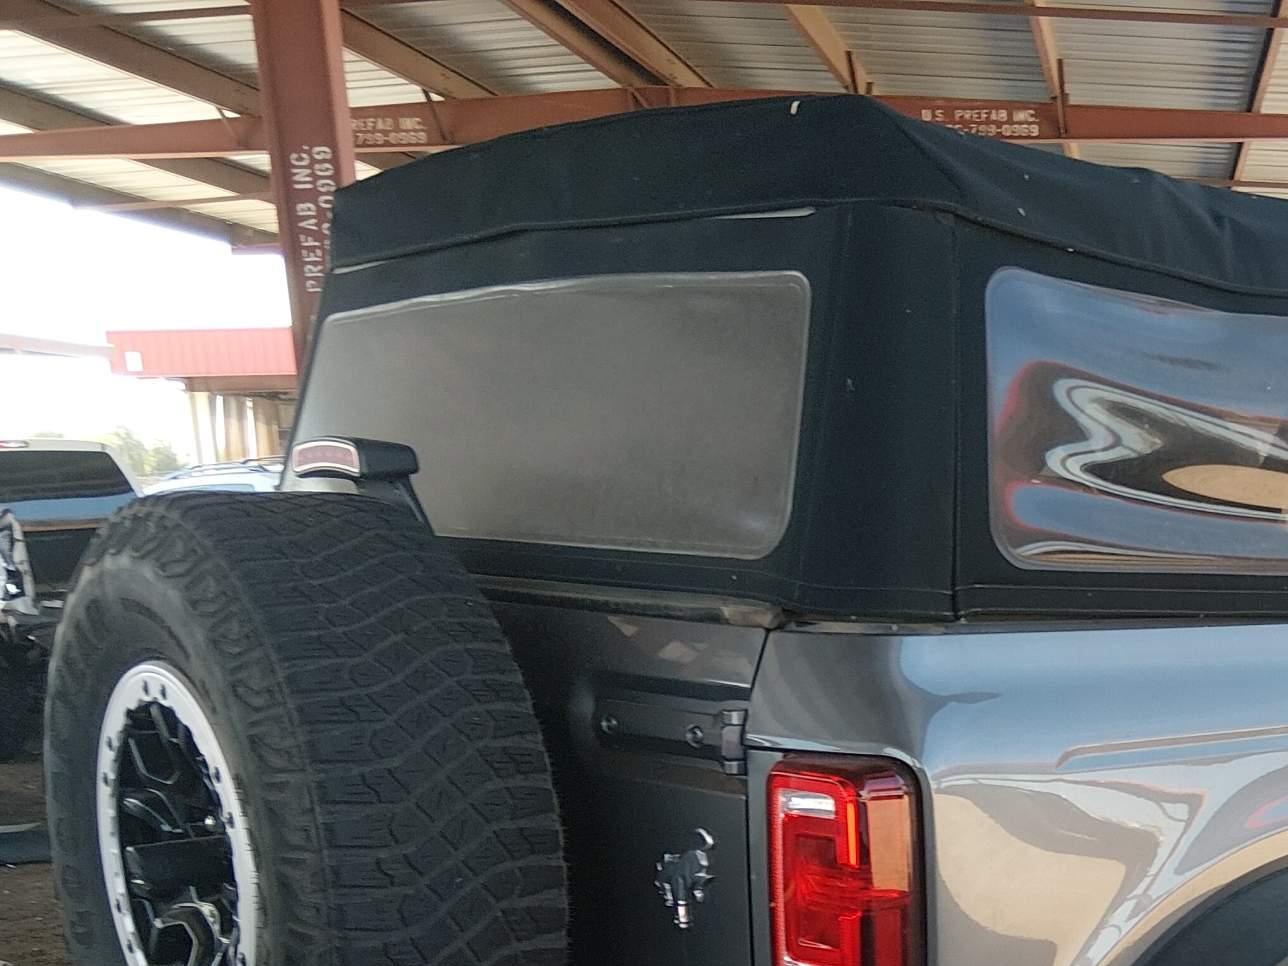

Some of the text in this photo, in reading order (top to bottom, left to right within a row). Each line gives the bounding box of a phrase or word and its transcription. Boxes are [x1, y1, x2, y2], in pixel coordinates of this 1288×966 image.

[954, 109, 1008, 122] PREFAB
[1012, 109, 1040, 122] INC.
[352, 117, 395, 130] REFAB
[289, 145, 325, 293] PREFAB INC.
